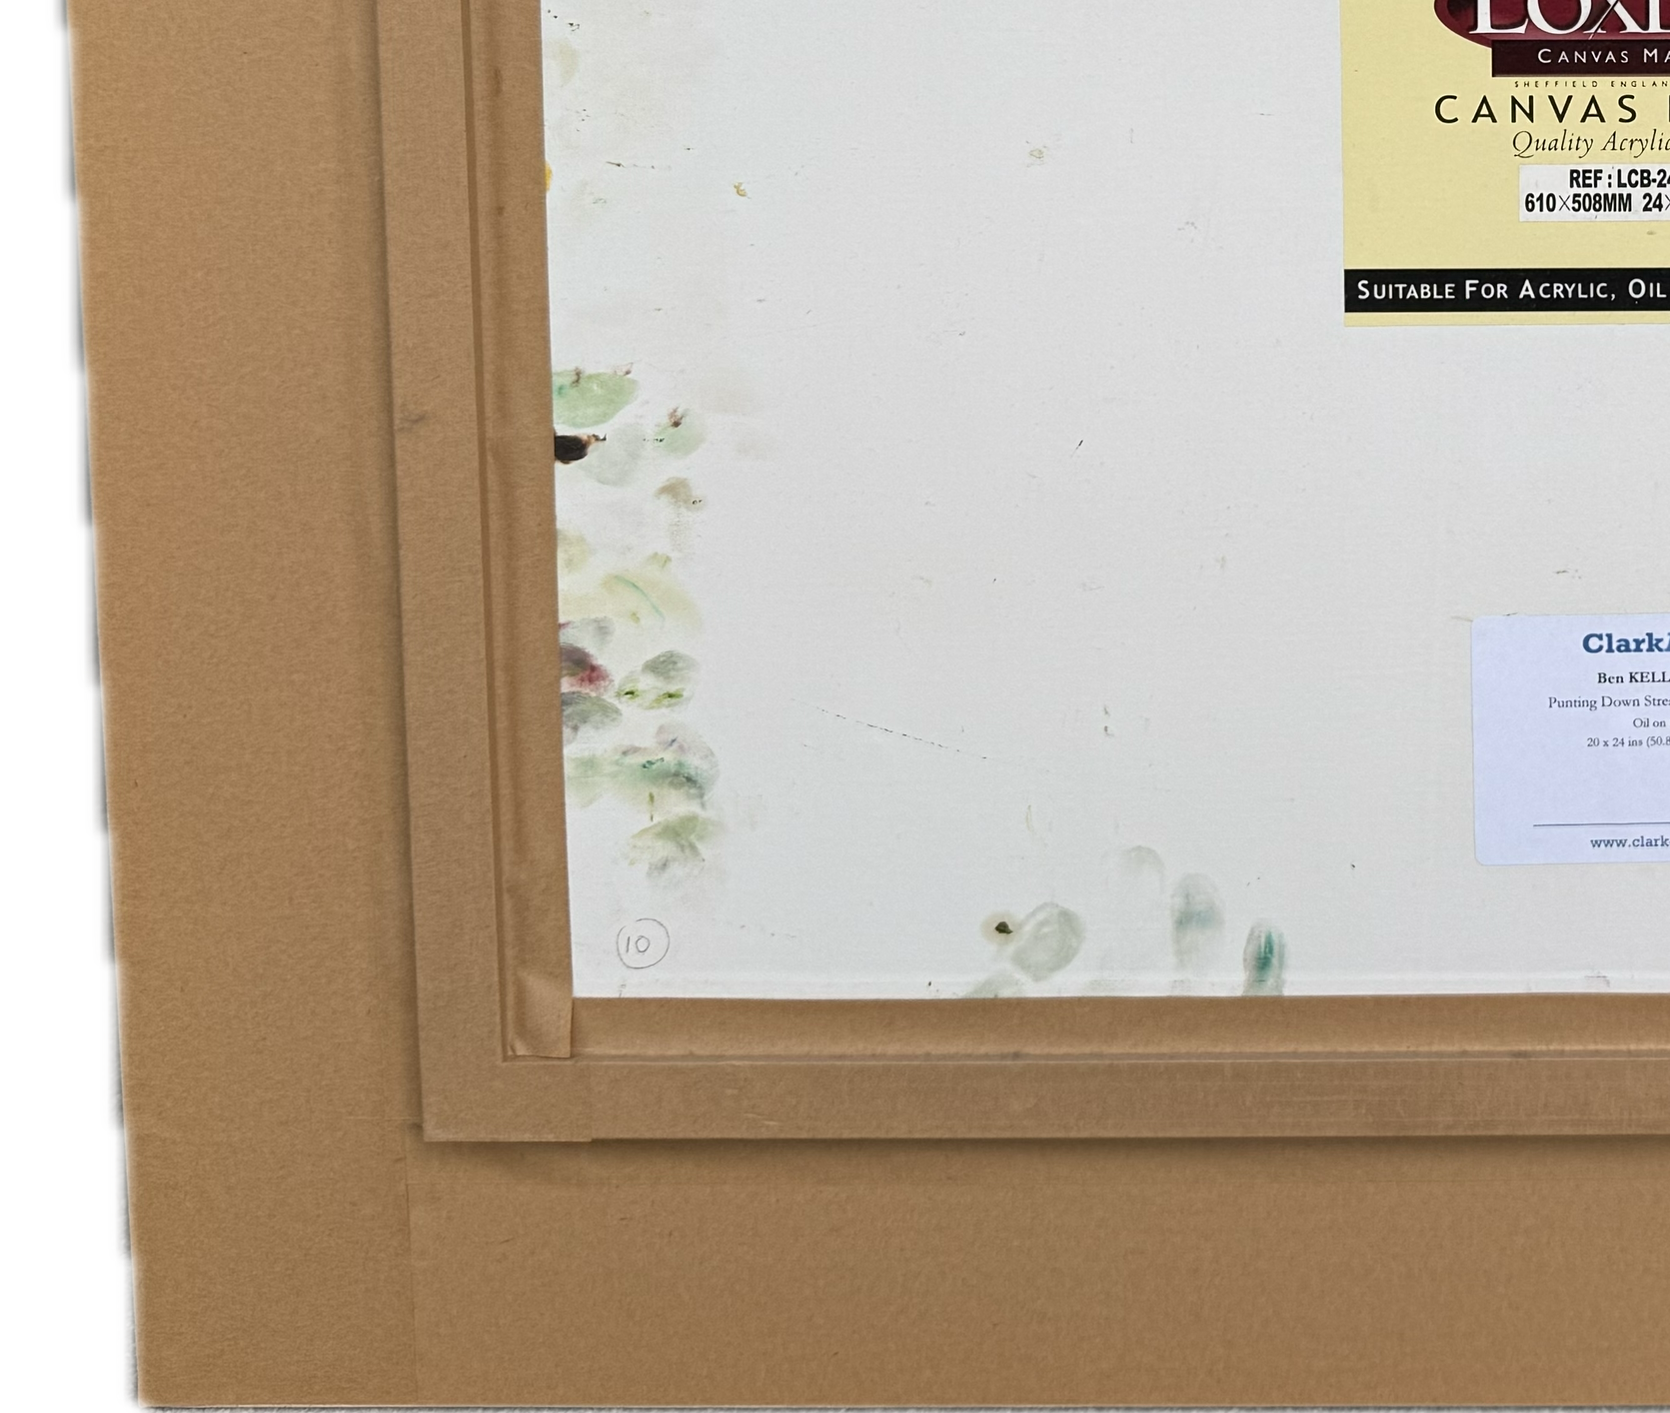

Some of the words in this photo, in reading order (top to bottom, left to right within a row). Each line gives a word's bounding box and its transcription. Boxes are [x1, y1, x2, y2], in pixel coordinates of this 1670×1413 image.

[1514, 80, 1598, 88] SHEFFIELD
[1434, 94, 1637, 124] CANVAS
[1512, 128, 1594, 159] Quality
[1597, 672, 1624, 685] Ben
[1548, 696, 1598, 712] Punting
[1601, 695, 1641, 708] Down
[1632, 717, 1650, 729] Oil
[1652, 720, 1667, 728] on
[1586, 737, 1600, 748] 20
[1602, 739, 1610, 748] x
[1612, 737, 1625, 748] 24
[1627, 735, 1643, 747] ins
[624, 935, 651, 955] 10
